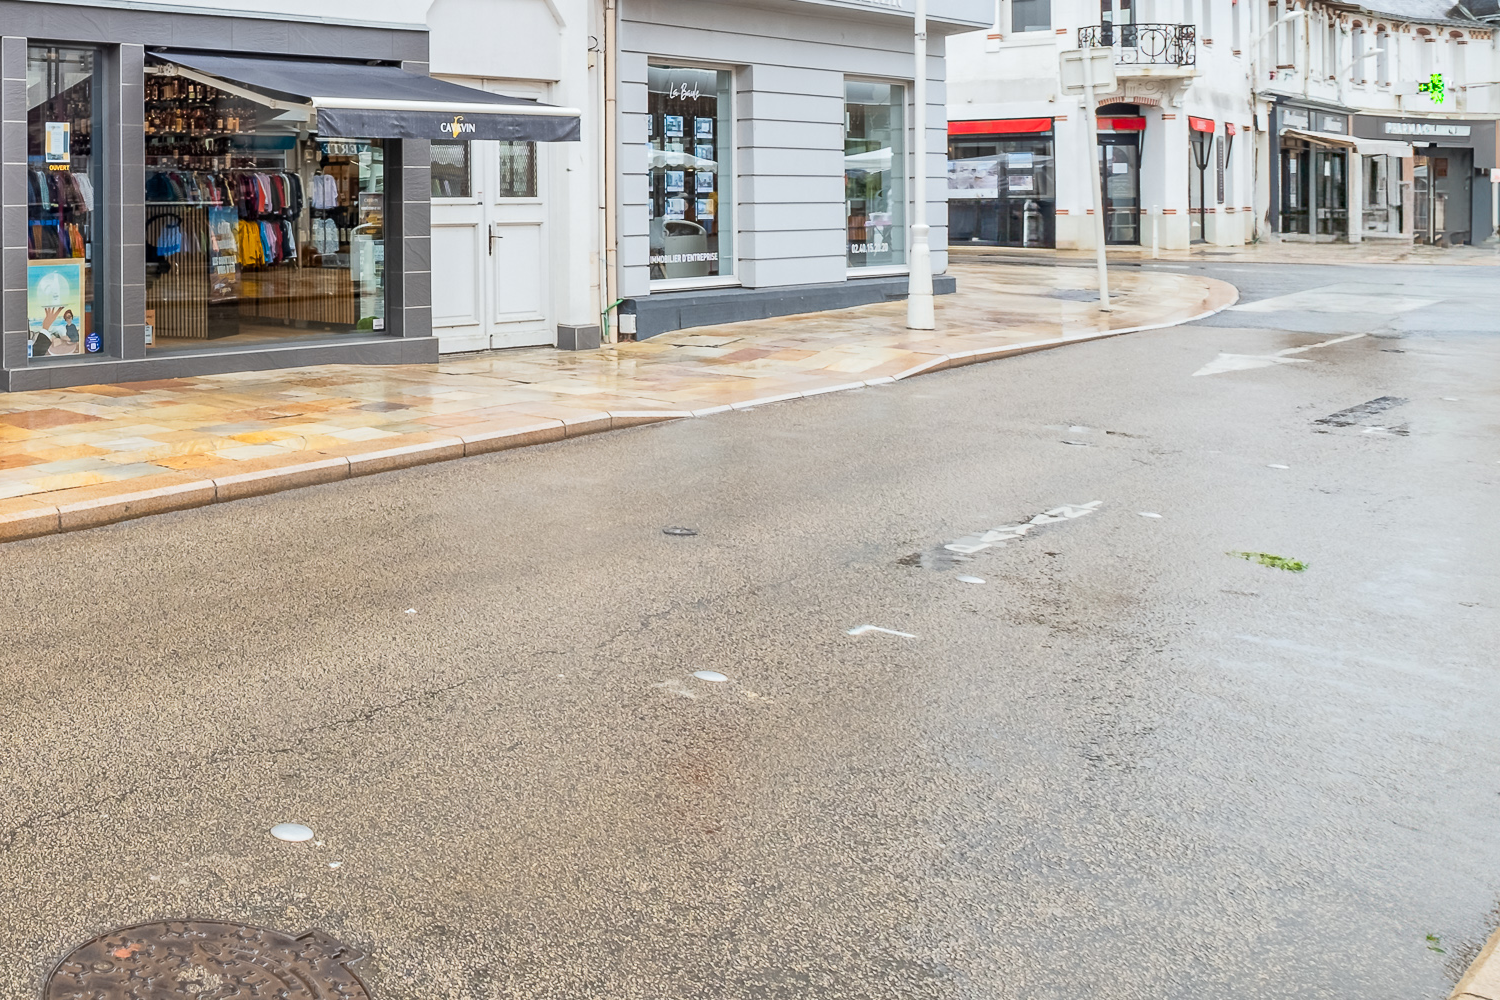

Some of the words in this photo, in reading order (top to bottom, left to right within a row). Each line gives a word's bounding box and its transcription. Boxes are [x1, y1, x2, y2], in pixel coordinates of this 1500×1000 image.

[440, 122, 476, 133] CAVAVIN
[649, 254, 681, 264] IMMOBILIER
[682, 252, 718, 263] D'ENTREPRISE
